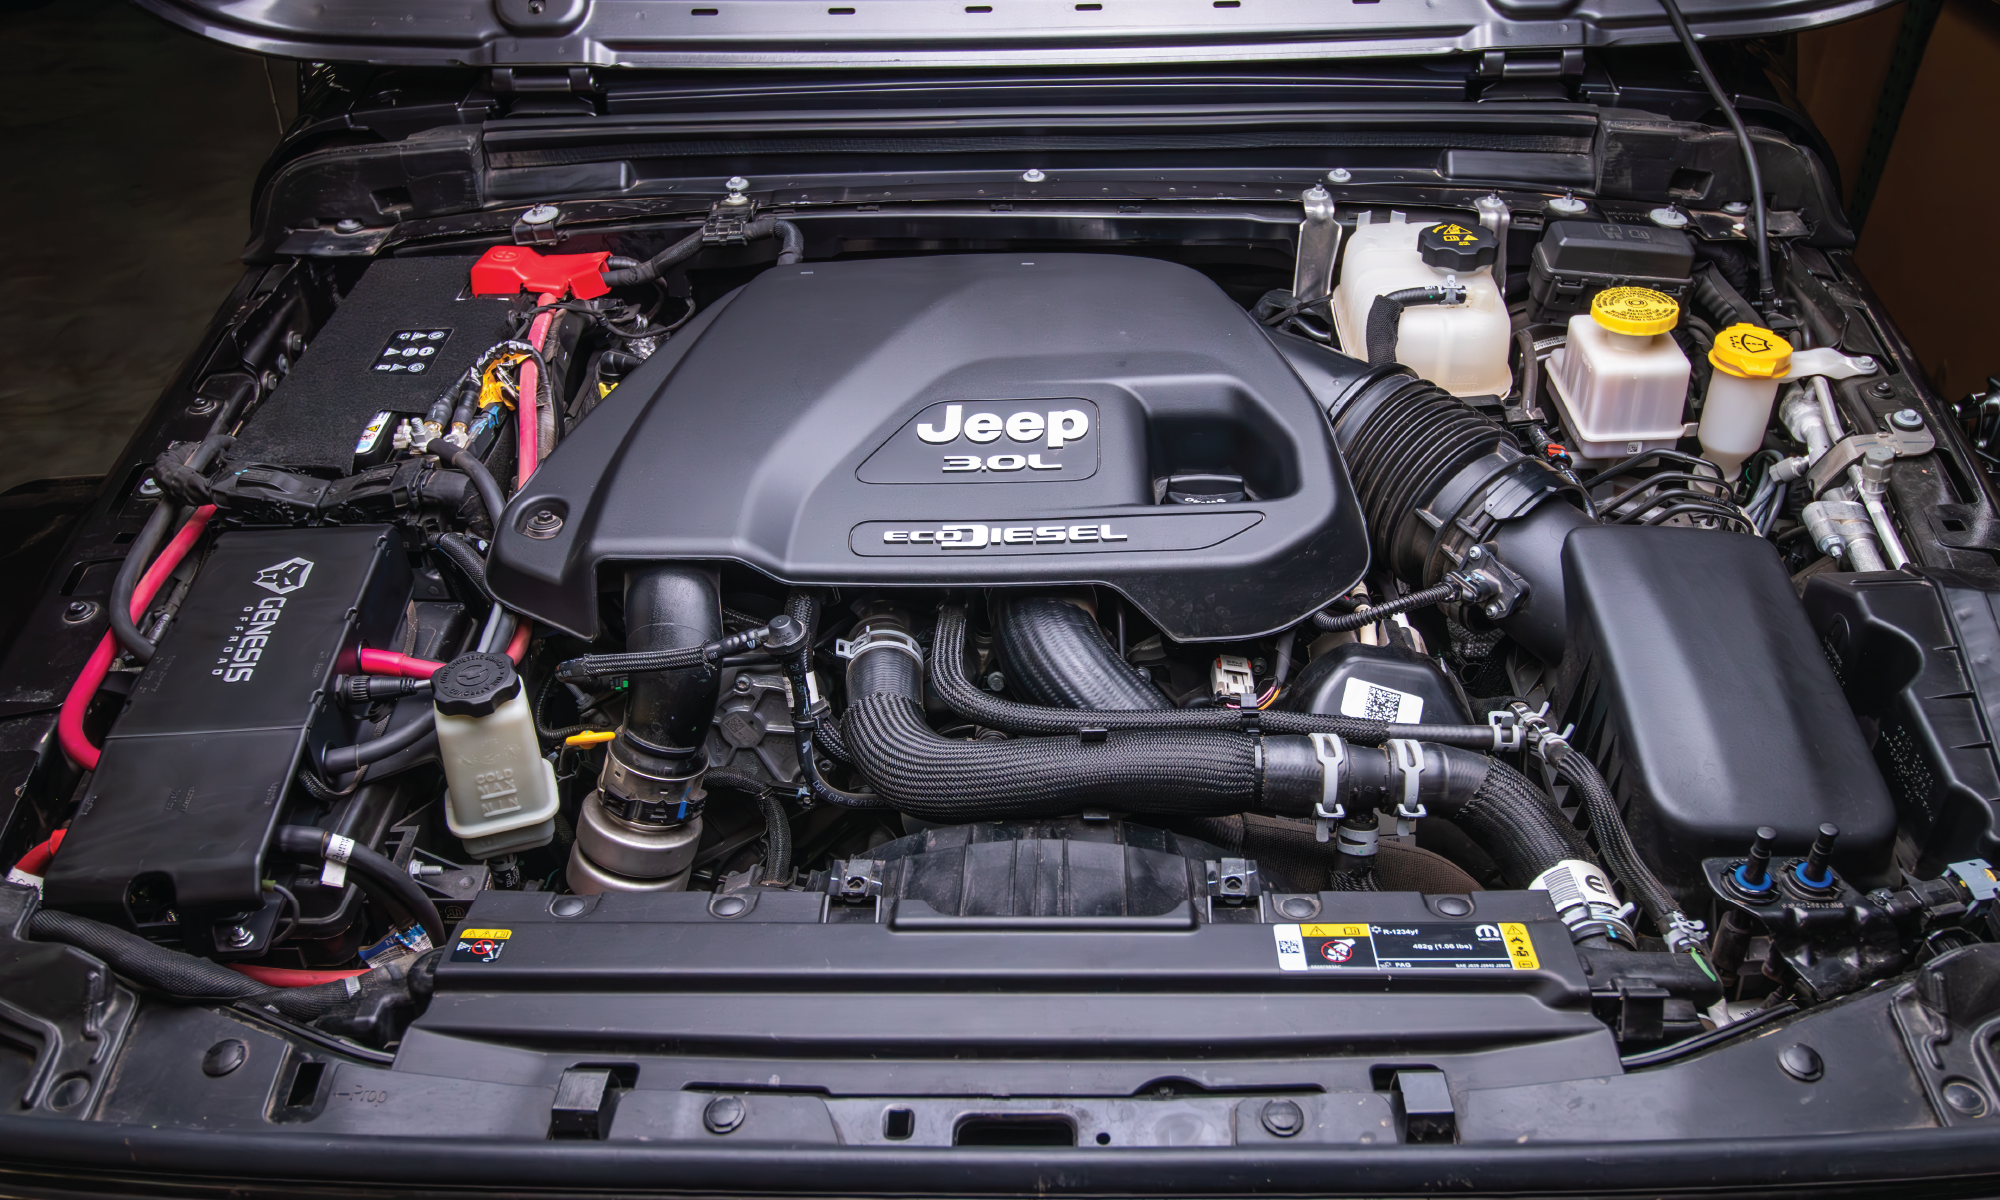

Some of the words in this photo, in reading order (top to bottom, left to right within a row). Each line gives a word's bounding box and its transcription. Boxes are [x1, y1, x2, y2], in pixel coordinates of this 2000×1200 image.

[916, 404, 1089, 449] Jeep
[942, 453, 1062, 474] 3.0L
[222, 597, 287, 683] GENESIS
[476, 768, 513, 784] COLD
[477, 779, 516, 795] MAX
[812, 779, 827, 794] DOT
[481, 797, 518, 813] MIN
[1382, 927, 1420, 936] R-1234yf
[1454, 942, 1473, 951] lbs)
[349, 1084, 388, 1108] Prop
